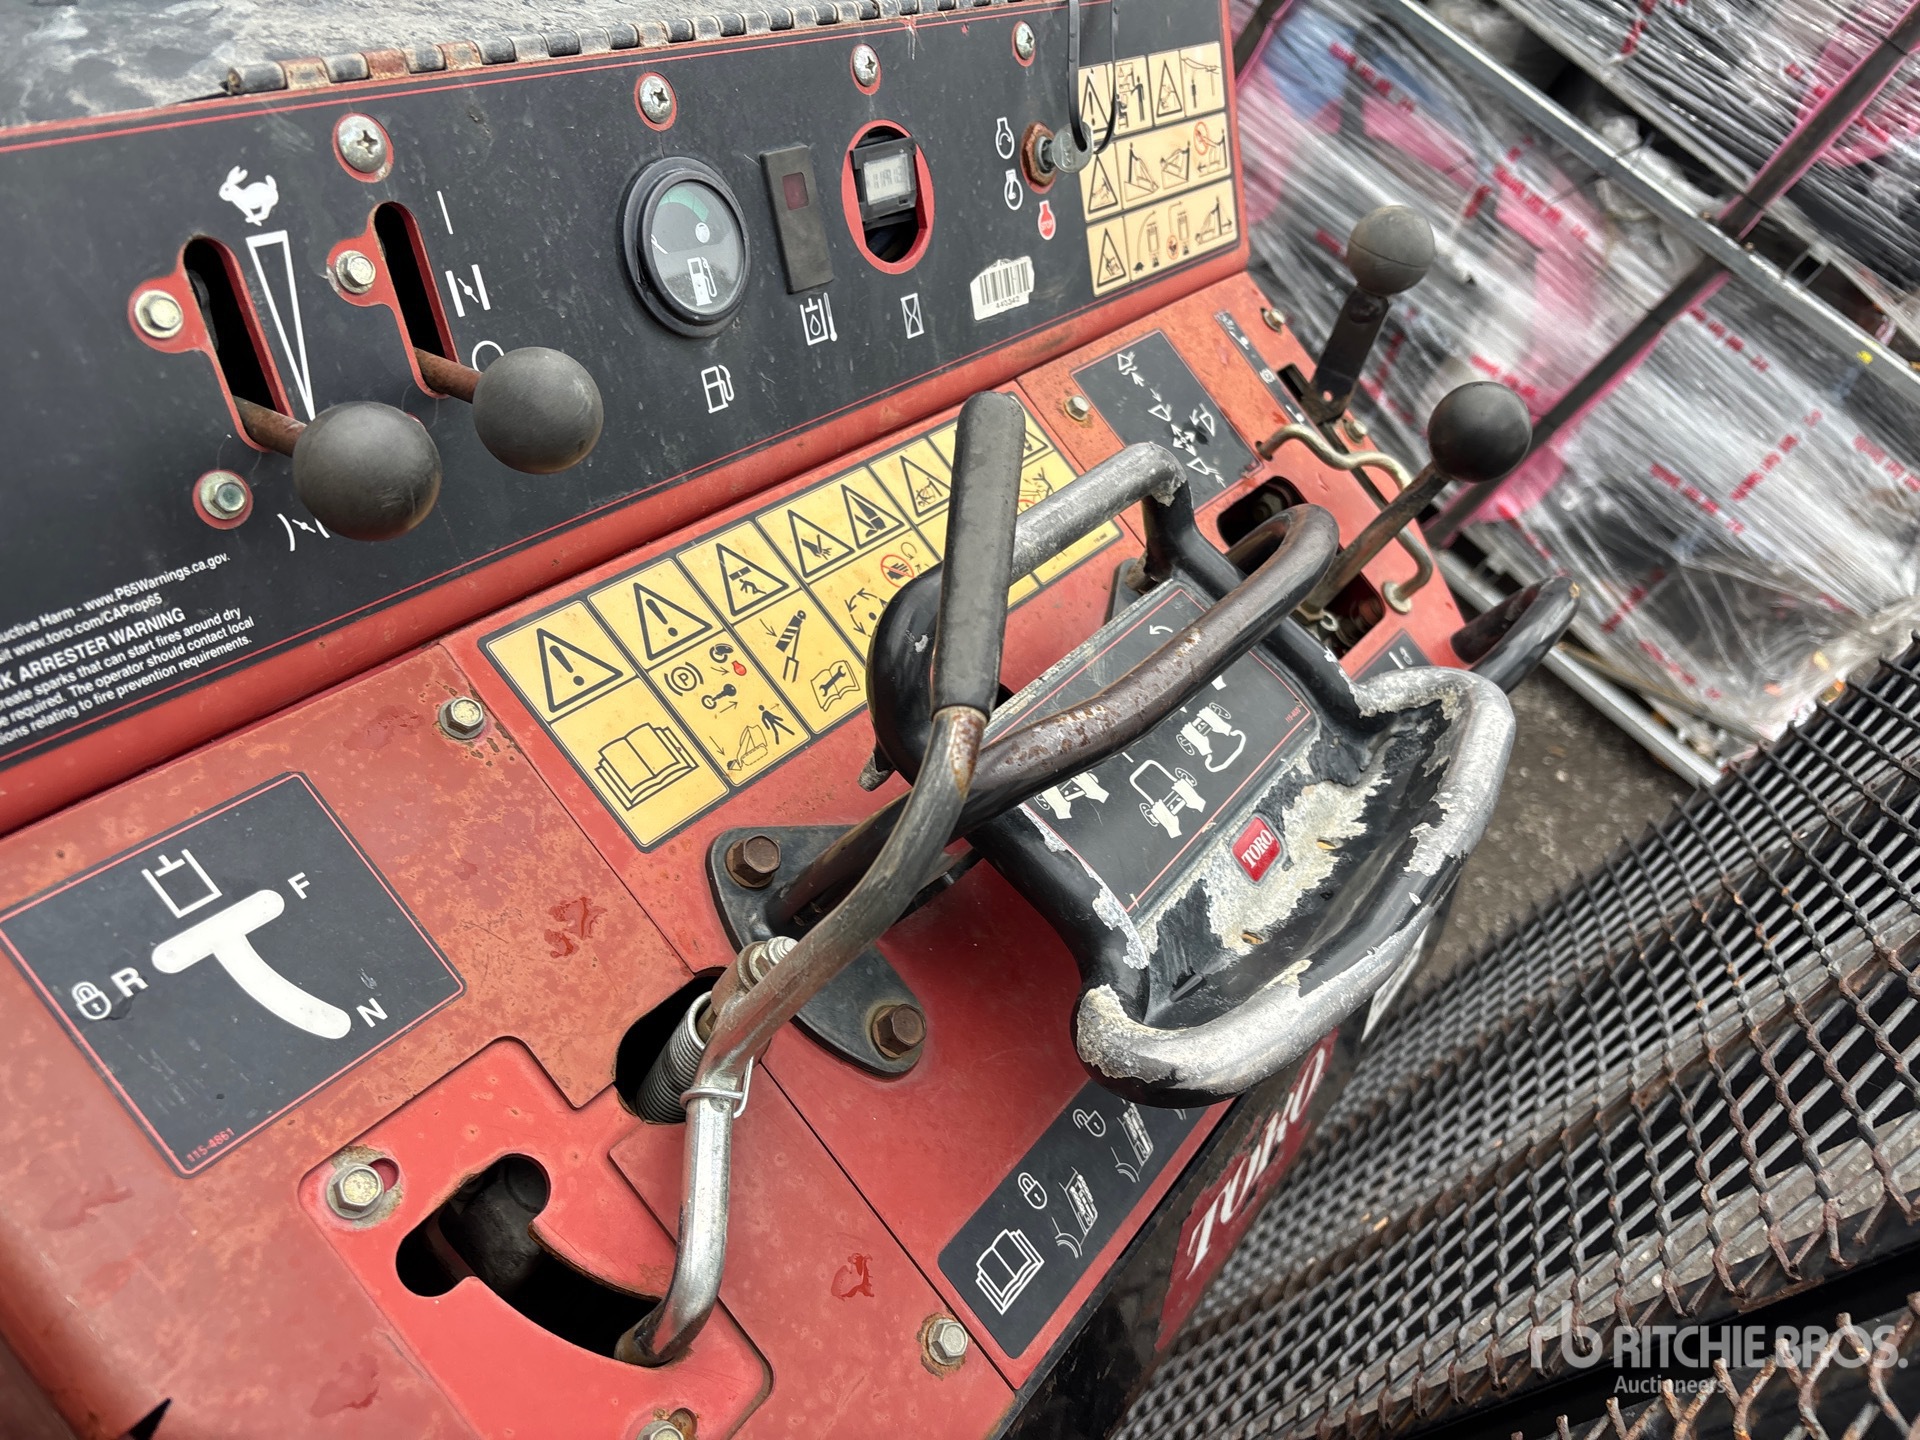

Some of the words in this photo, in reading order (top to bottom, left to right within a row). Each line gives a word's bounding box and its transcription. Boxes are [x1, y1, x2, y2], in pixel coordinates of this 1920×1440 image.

[38, 607, 76, 627] Harm
[83, 552, 231, 613] www.P65Warnings.ca.gov.
[13, 592, 163, 656] www.toro.com/CAProp65
[19, 635, 111, 683] ARRESTER
[108, 607, 186, 647] WARNING
[33, 671, 77, 695] sparks
[76, 660, 103, 678] that
[103, 651, 127, 668] can
[127, 639, 156, 659] start
[155, 629, 182, 647] fires
[183, 615, 223, 637] around
[223, 606, 241, 621] dry
[9, 691, 67, 722] required.
[67, 681, 95, 698] The
[94, 659, 145, 688] operator
[146, 641, 187, 668] should
[186, 627, 229, 651] contact
[227, 615, 255, 634] local
[30, 705, 80, 732] relating
[78, 698, 93, 712] to
[92, 689, 116, 705] fire
[116, 664, 178, 699] prevention
[178, 634, 253, 669] requirements.
[1241, 828, 1275, 869] TORO
[287, 871, 312, 900] F
[110, 966, 149, 998] R
[355, 997, 389, 1028] N
[186, 1127, 236, 1163] 115-4861
